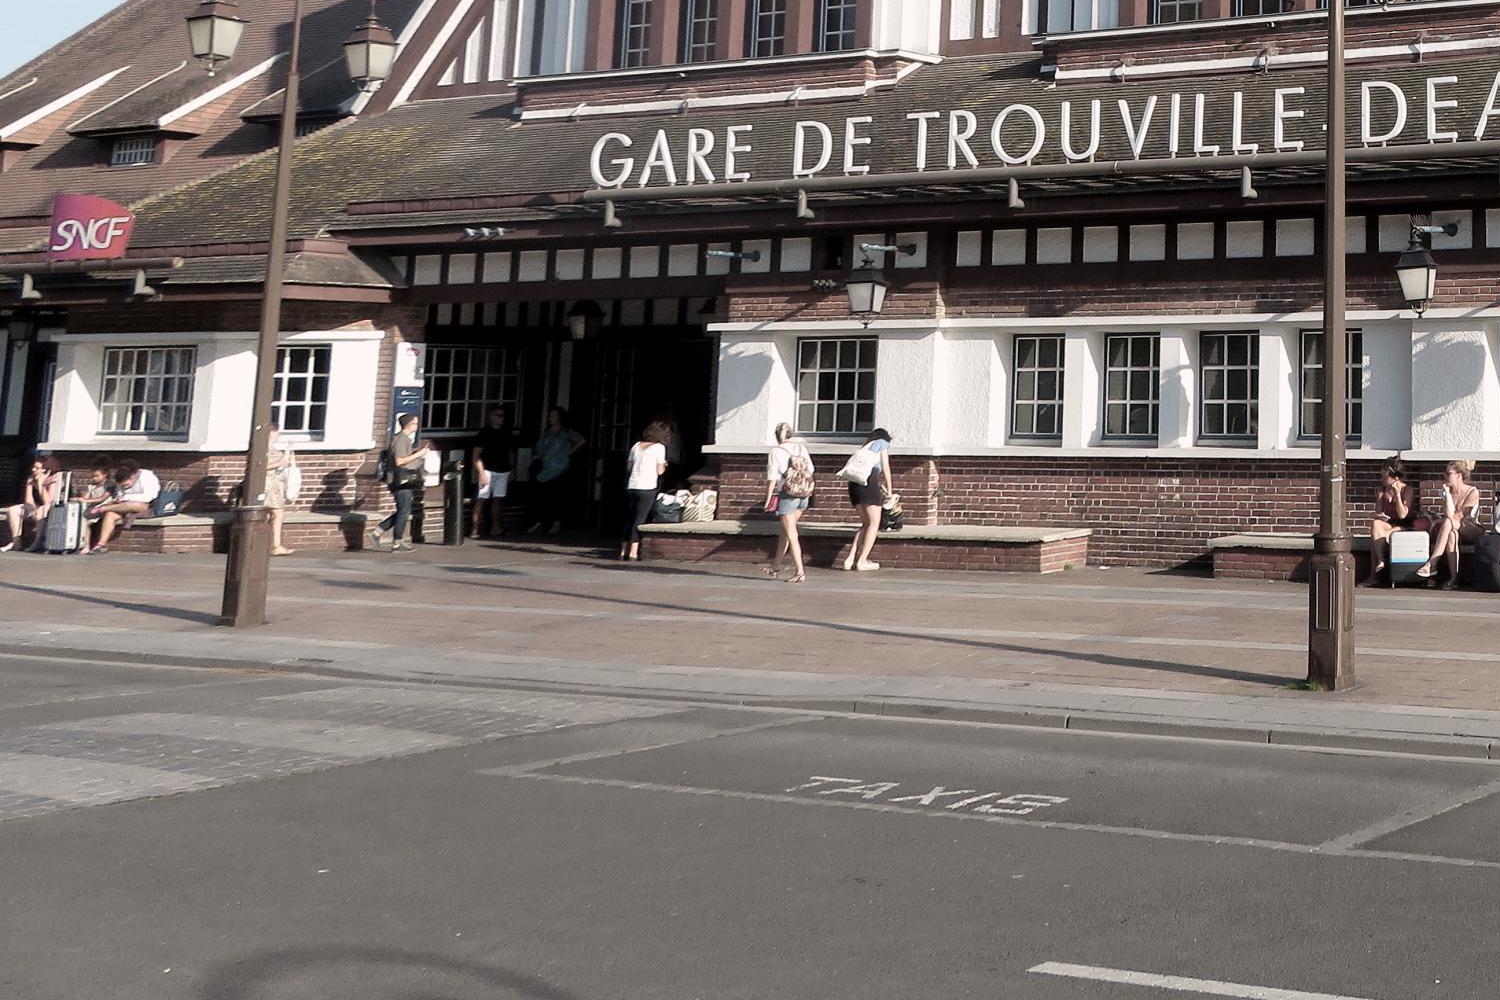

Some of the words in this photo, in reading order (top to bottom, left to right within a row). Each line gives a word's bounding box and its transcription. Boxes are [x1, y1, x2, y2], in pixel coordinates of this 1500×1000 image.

[590, 124, 754, 189] GARE
[793, 116, 873, 178] DE
[906, 86, 1305, 171] TROUVILLE
[51, 216, 130, 251] SNCF
[786, 775, 1071, 816] TAXIS
